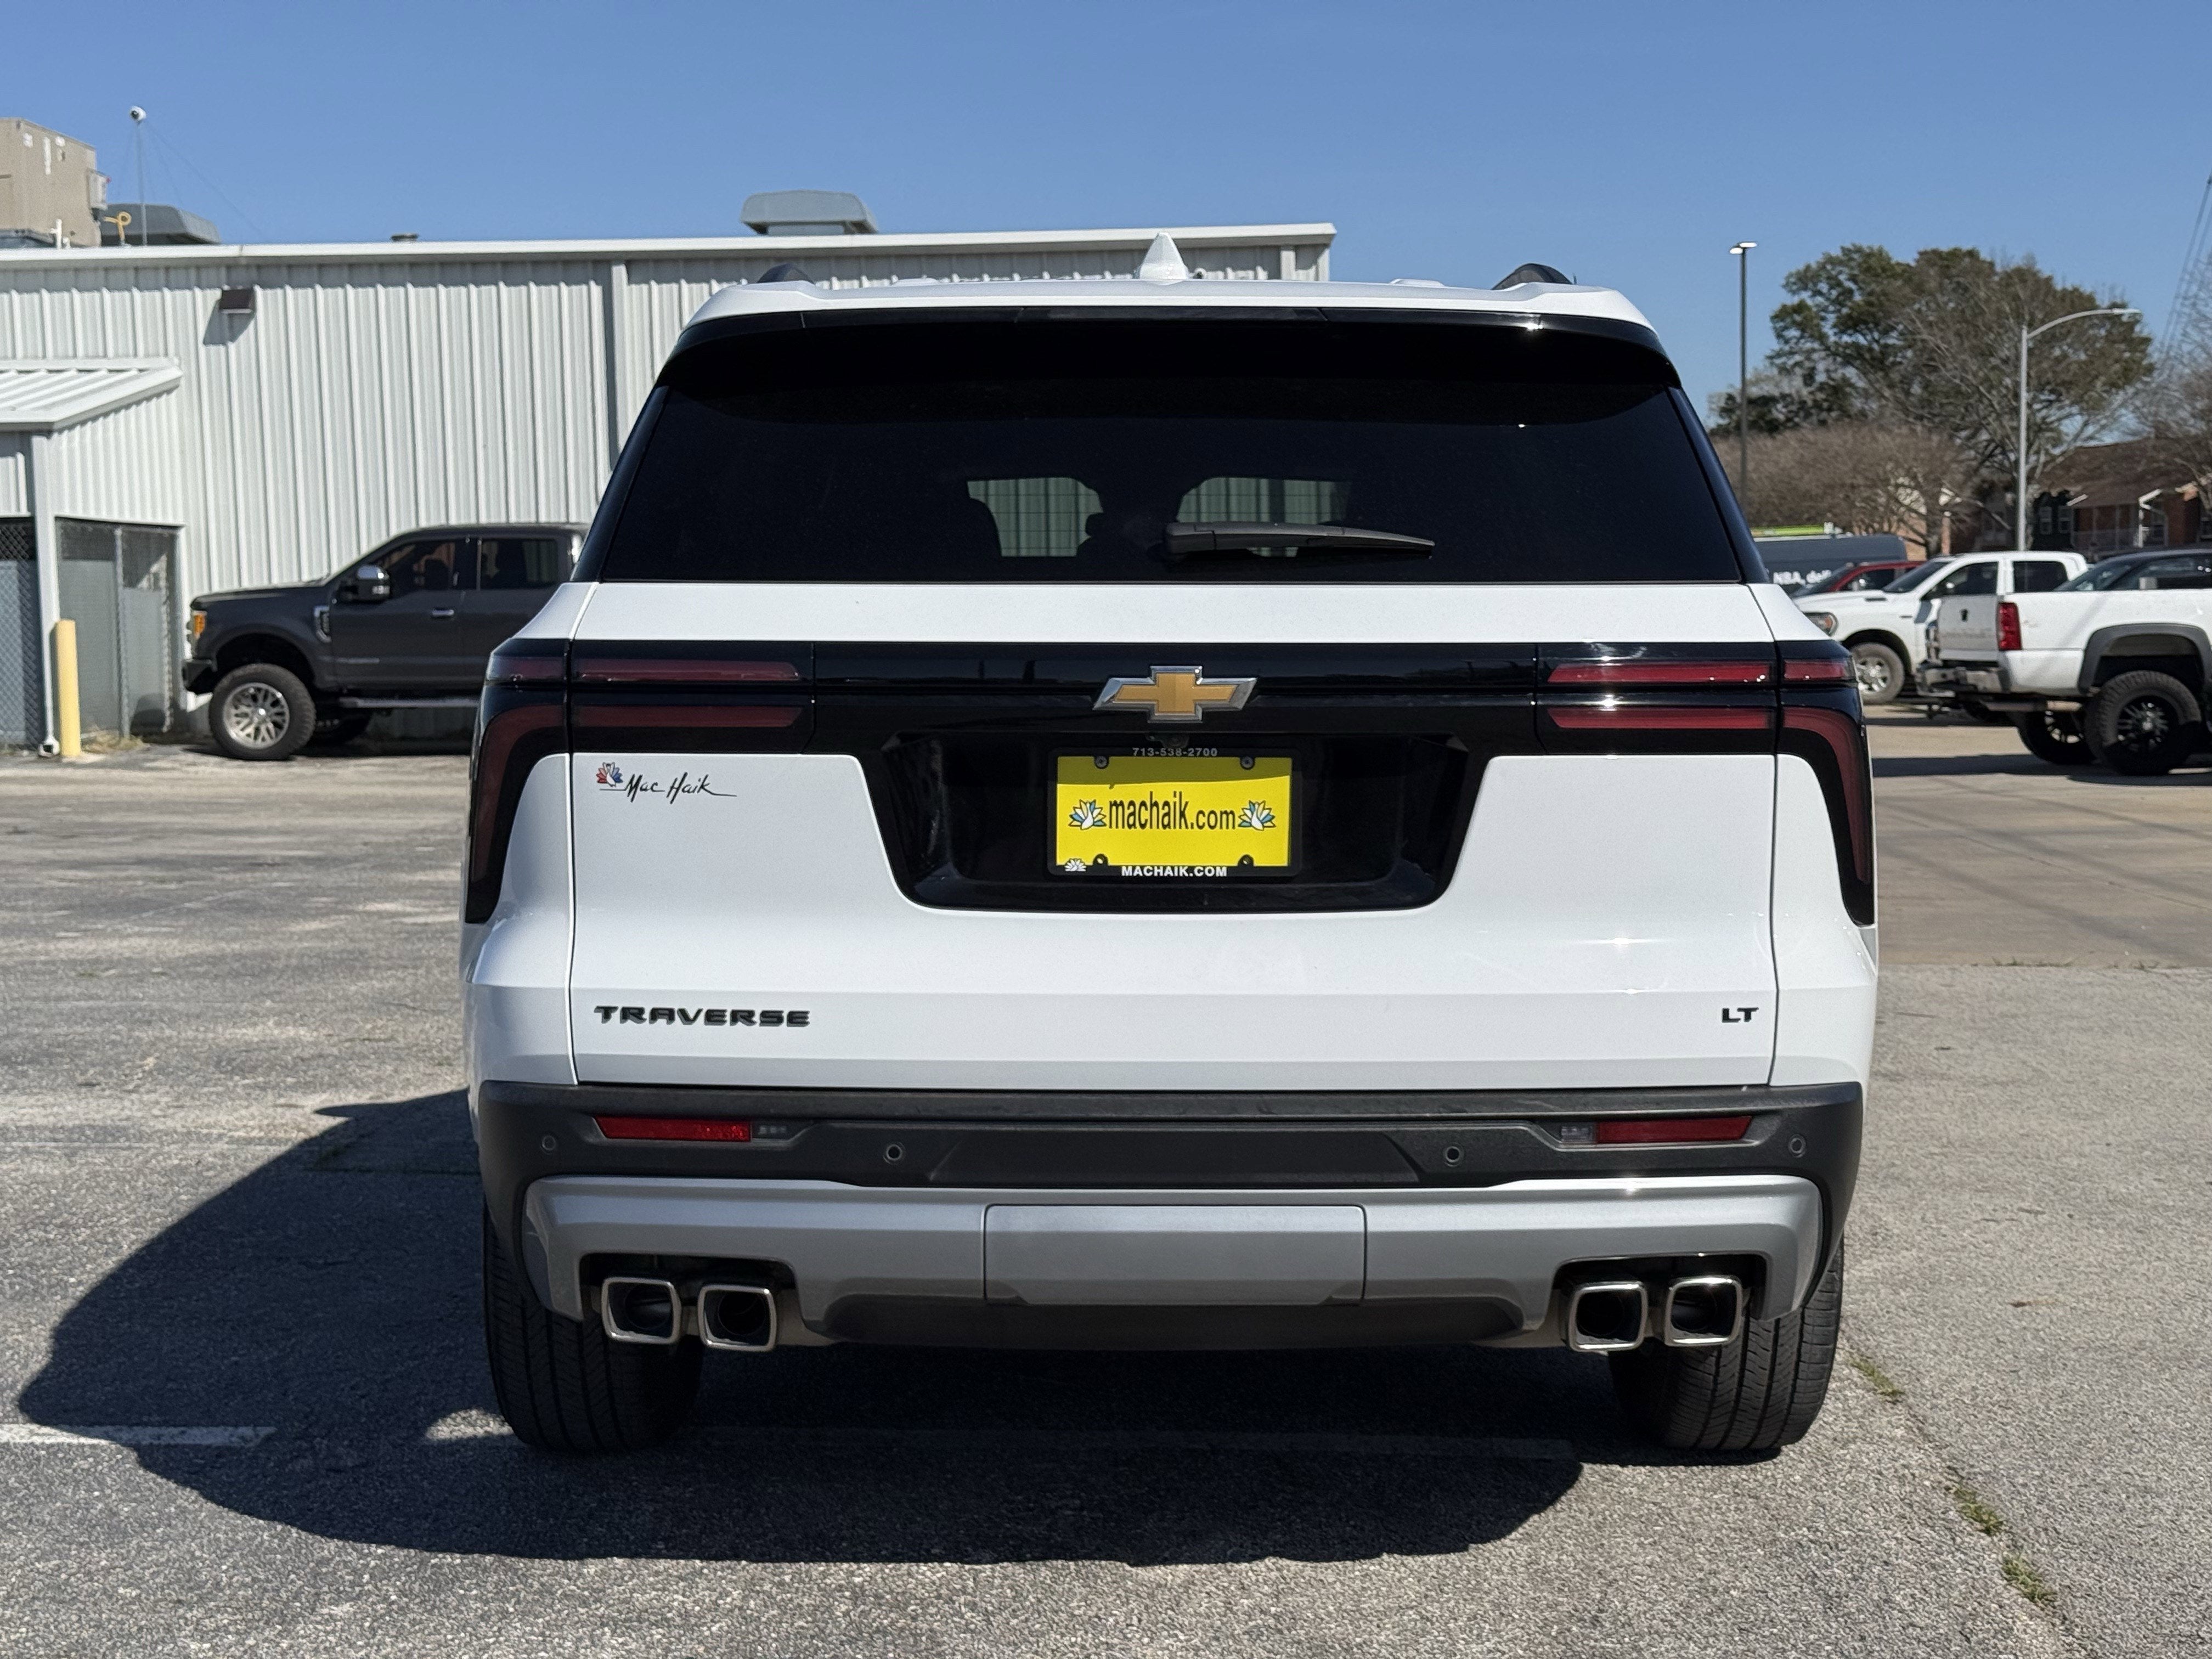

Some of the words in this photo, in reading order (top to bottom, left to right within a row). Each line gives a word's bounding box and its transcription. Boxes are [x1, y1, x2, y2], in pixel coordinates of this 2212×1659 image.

[1132, 748, 1218, 757] 713-538-2700
[612, 774, 665, 803] Mac
[667, 772, 737, 804] Haik
[1109, 791, 1235, 830] machaik.com
[1121, 866, 1227, 877] MACHAIK.COM
[594, 1006, 810, 1027] TRAVERSE
[1722, 1007, 1759, 1023] LT
